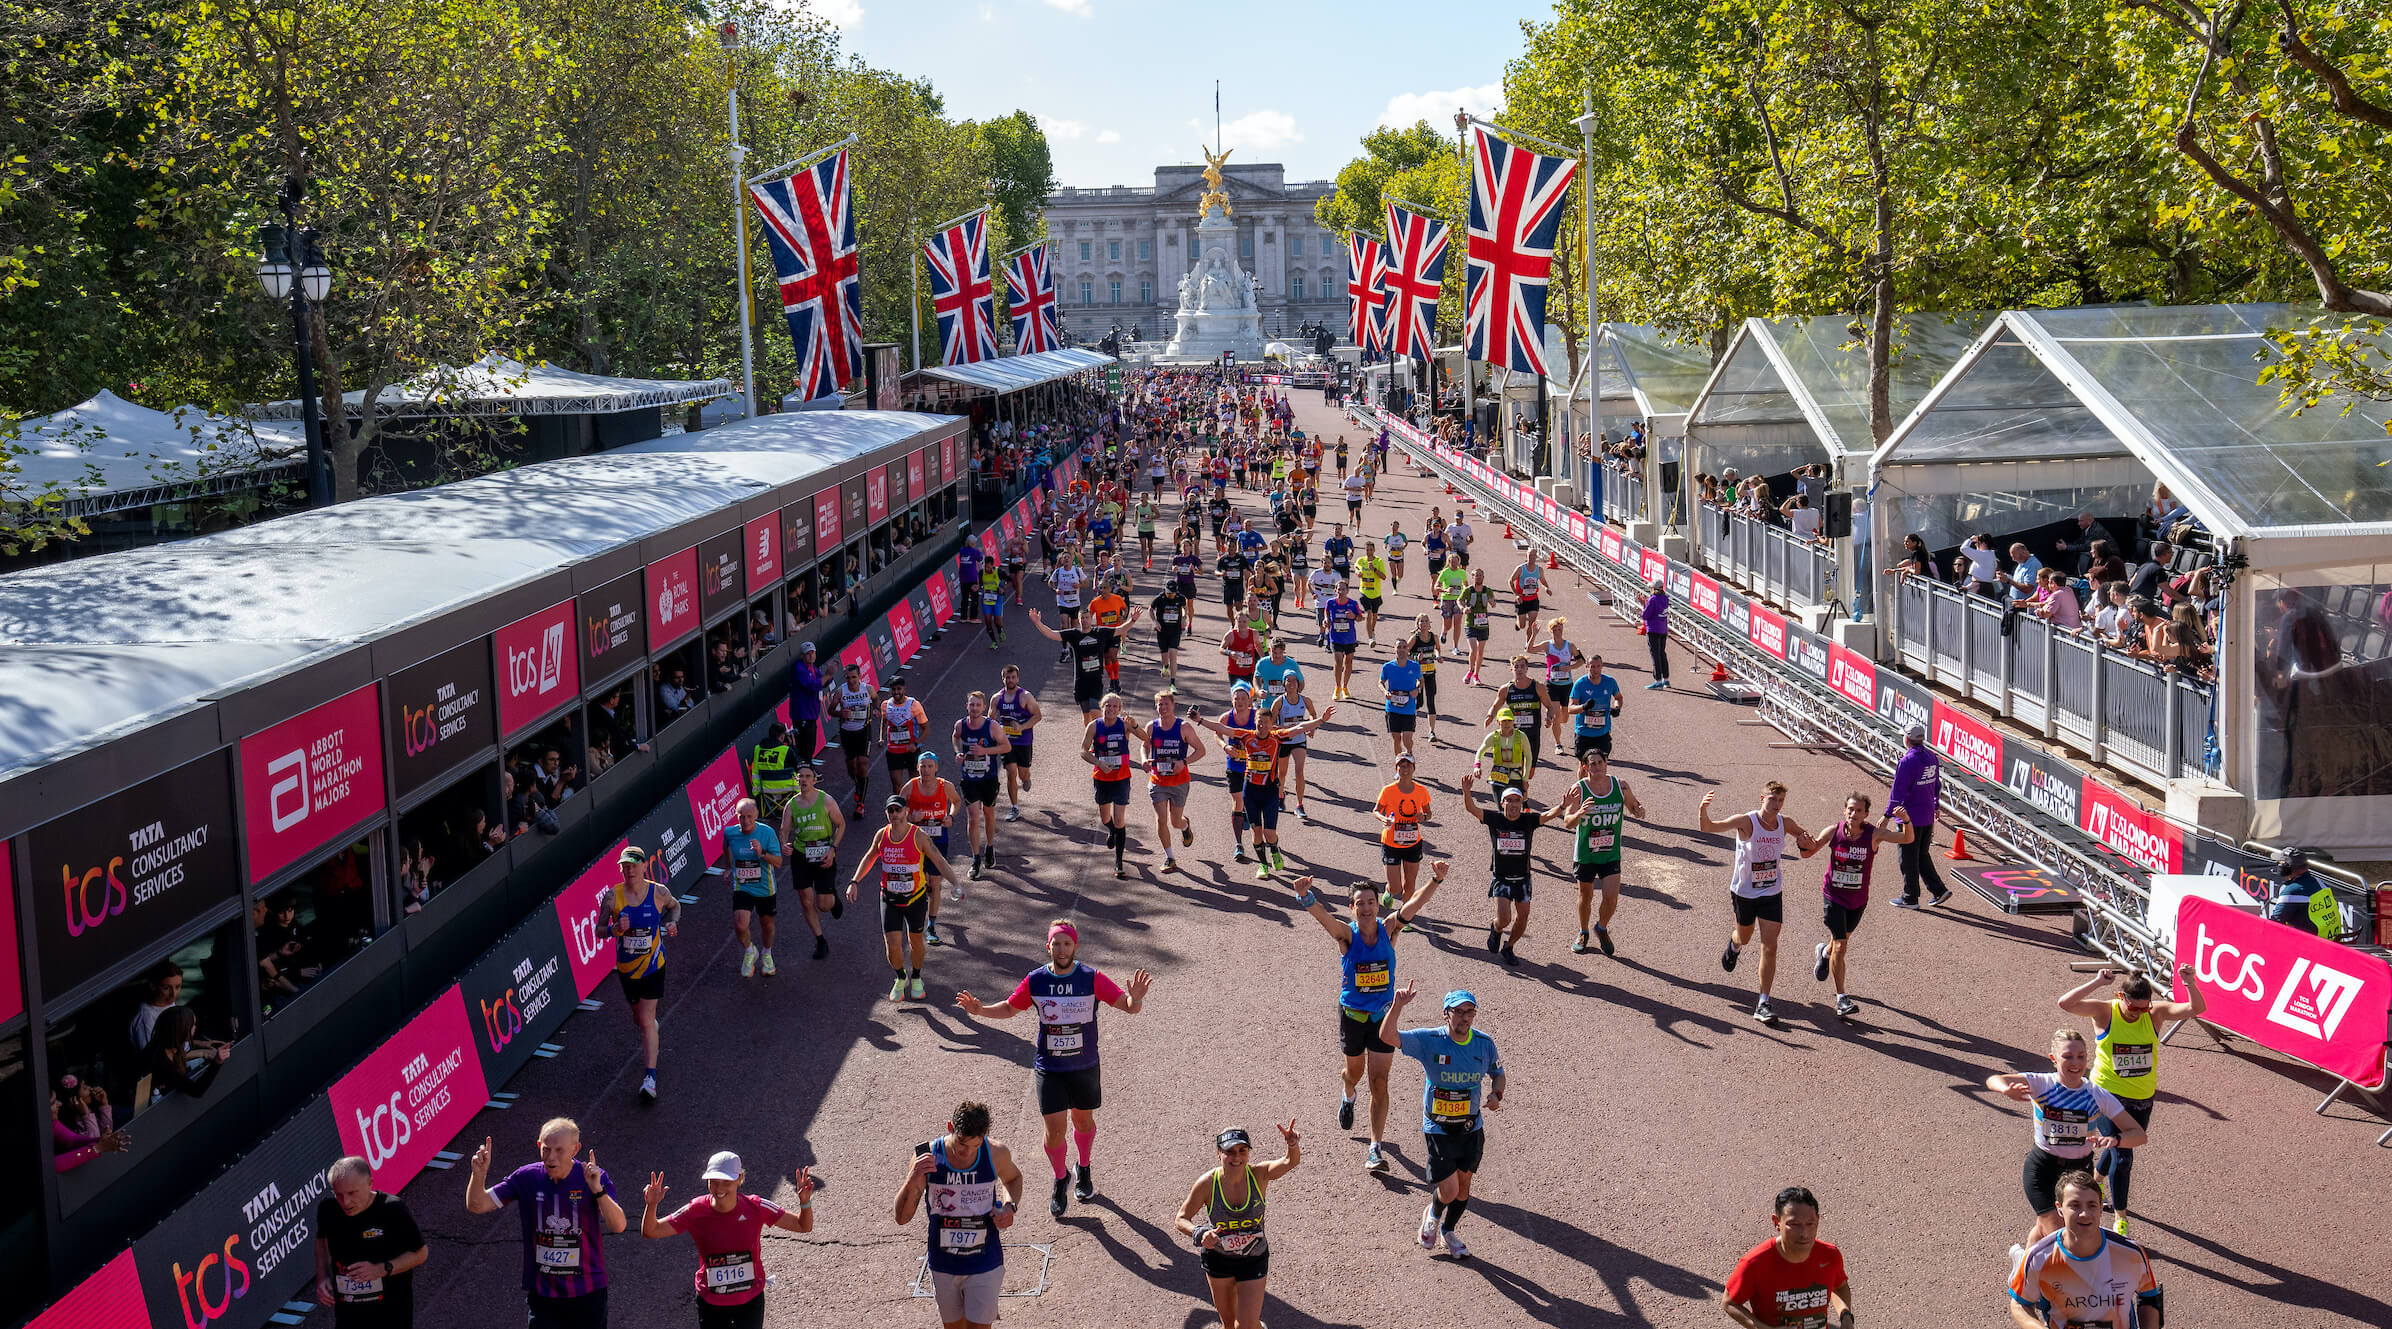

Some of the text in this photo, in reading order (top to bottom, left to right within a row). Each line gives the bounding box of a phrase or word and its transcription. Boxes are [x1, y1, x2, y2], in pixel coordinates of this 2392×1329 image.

[673, 581, 688, 599] ROYAL
[674, 598, 689, 616] PARKS
[589, 616, 610, 658] tcs
[509, 646, 537, 697] tcs
[437, 682, 456, 702] TATA
[1844, 678, 1872, 707] MARATHON
[439, 689, 479, 722] CONSULTANCY
[403, 704, 437, 758] tcs
[440, 715, 467, 741] SERVICES
[311, 728, 344, 758] ABBOTT
[311, 748, 342, 776] WORLD
[1954, 743, 1995, 780] MARATHON
[313, 756, 362, 794] MARATHON
[315, 781, 350, 813] MAJORS
[2030, 787, 2075, 825] MARATHON
[698, 798, 722, 840] tcs
[1581, 813, 1621, 827] JOHN
[129, 820, 165, 852] TATA
[665, 829, 692, 862] CONSULTANCY
[1501, 840, 1521, 848] 36033
[131, 824, 208, 878] CONSULTANCY
[1835, 850, 1867, 860] mencap
[1849, 846, 1867, 854] JOHN
[669, 853, 688, 878] SERVICES
[1755, 871, 1777, 880] 37241
[63, 856, 127, 937] tcs
[134, 863, 184, 905] SERVICES
[512, 957, 533, 984] TATA
[2195, 922, 2265, 1001] tcs
[518, 955, 559, 1003] CONSULTANCY
[1049, 983, 1073, 995] TOM
[1359, 973, 1386, 984] 32649
[523, 987, 551, 1024] SERVICES
[2293, 1000, 2315, 1012] LONDON
[2299, 995, 2310, 1003] TCS
[481, 988, 522, 1053] tcs
[2289, 1005, 2318, 1020] MARATHON
[1054, 1037, 1076, 1047] 2573
[401, 1052, 429, 1084] TATA
[2118, 1055, 2147, 1066] 26141
[408, 1045, 463, 1107] CONSULTANCY
[1441, 1071, 1481, 1083] CHUCHO
[414, 1085, 451, 1131] SERVICES
[1436, 1100, 1465, 1112] 31384
[356, 1091, 411, 1171] tcs
[1222, 1132, 1239, 1141] MEX
[2050, 1123, 2078, 1135] 3813
[946, 1171, 977, 1184] MATT
[242, 1182, 281, 1224] TATA
[961, 1188, 990, 1197] CANCER
[961, 1193, 993, 1203] RESEARCH
[250, 1168, 328, 1251] CONSULTANCY
[1216, 1215, 1263, 1230] CECY
[256, 1218, 309, 1280] SERVICES
[950, 1232, 977, 1243] 7977
[543, 1250, 570, 1263] 4427
[173, 1234, 250, 1329] tcs
[344, 1279, 372, 1291] 7344
[716, 1267, 744, 1282] 6116
[2065, 1293, 2125, 1308] ARCHIE
